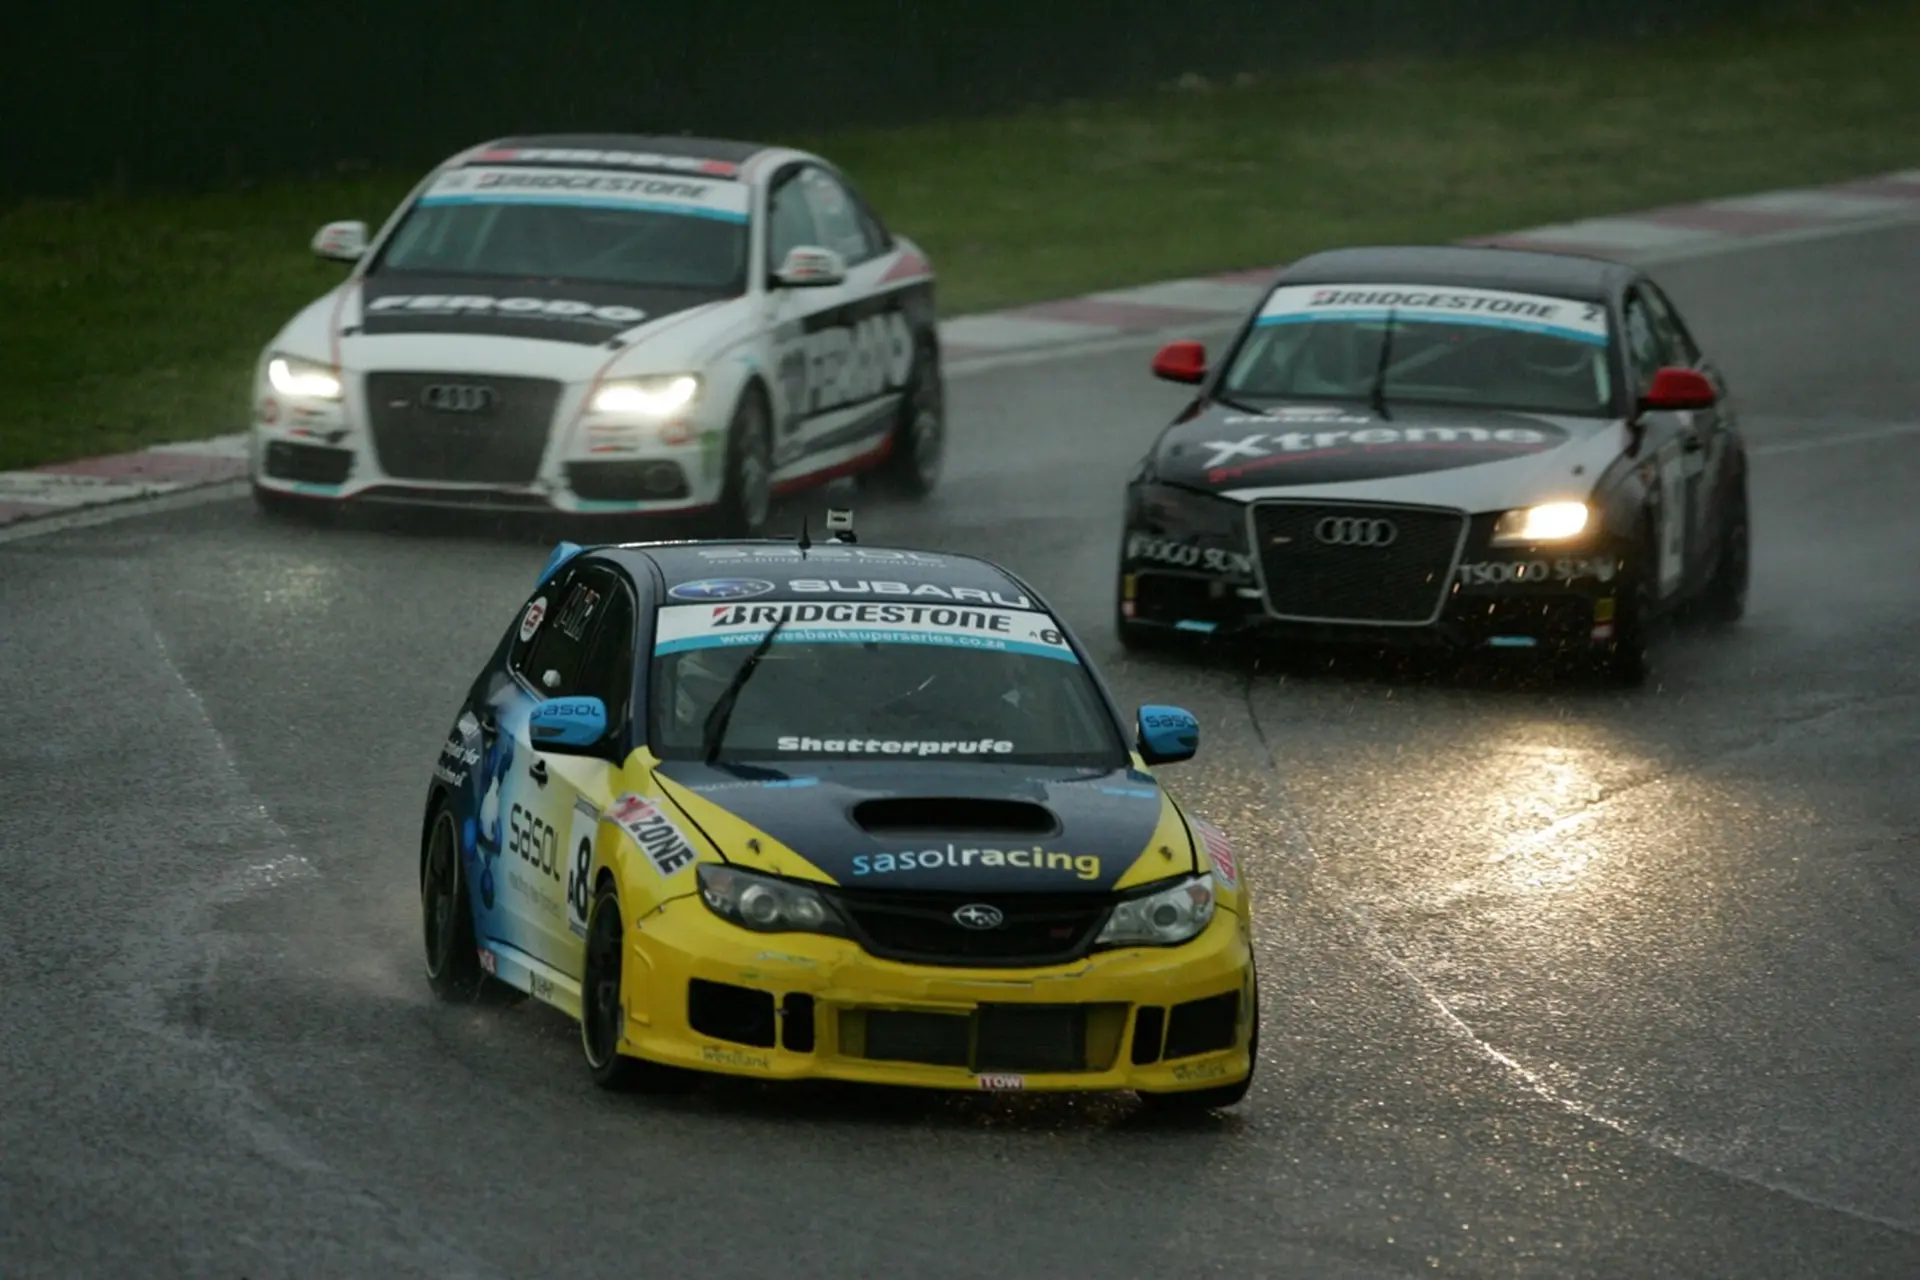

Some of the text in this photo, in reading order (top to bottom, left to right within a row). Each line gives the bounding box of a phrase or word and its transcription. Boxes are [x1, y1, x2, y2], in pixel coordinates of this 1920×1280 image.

[1306, 290, 1561, 318] BRIDGESTONE
[1202, 426, 1547, 470] Xtreme
[789, 578, 1032, 608] SUBARU
[711, 603, 1012, 632] BRIDGESTONE
[719, 629, 1006, 650] wwwwesbanksuperseries.co.za
[777, 735, 1014, 757] Shatterprufe
[851, 843, 1101, 880] sasolracing
[575, 836, 592, 923] 8
